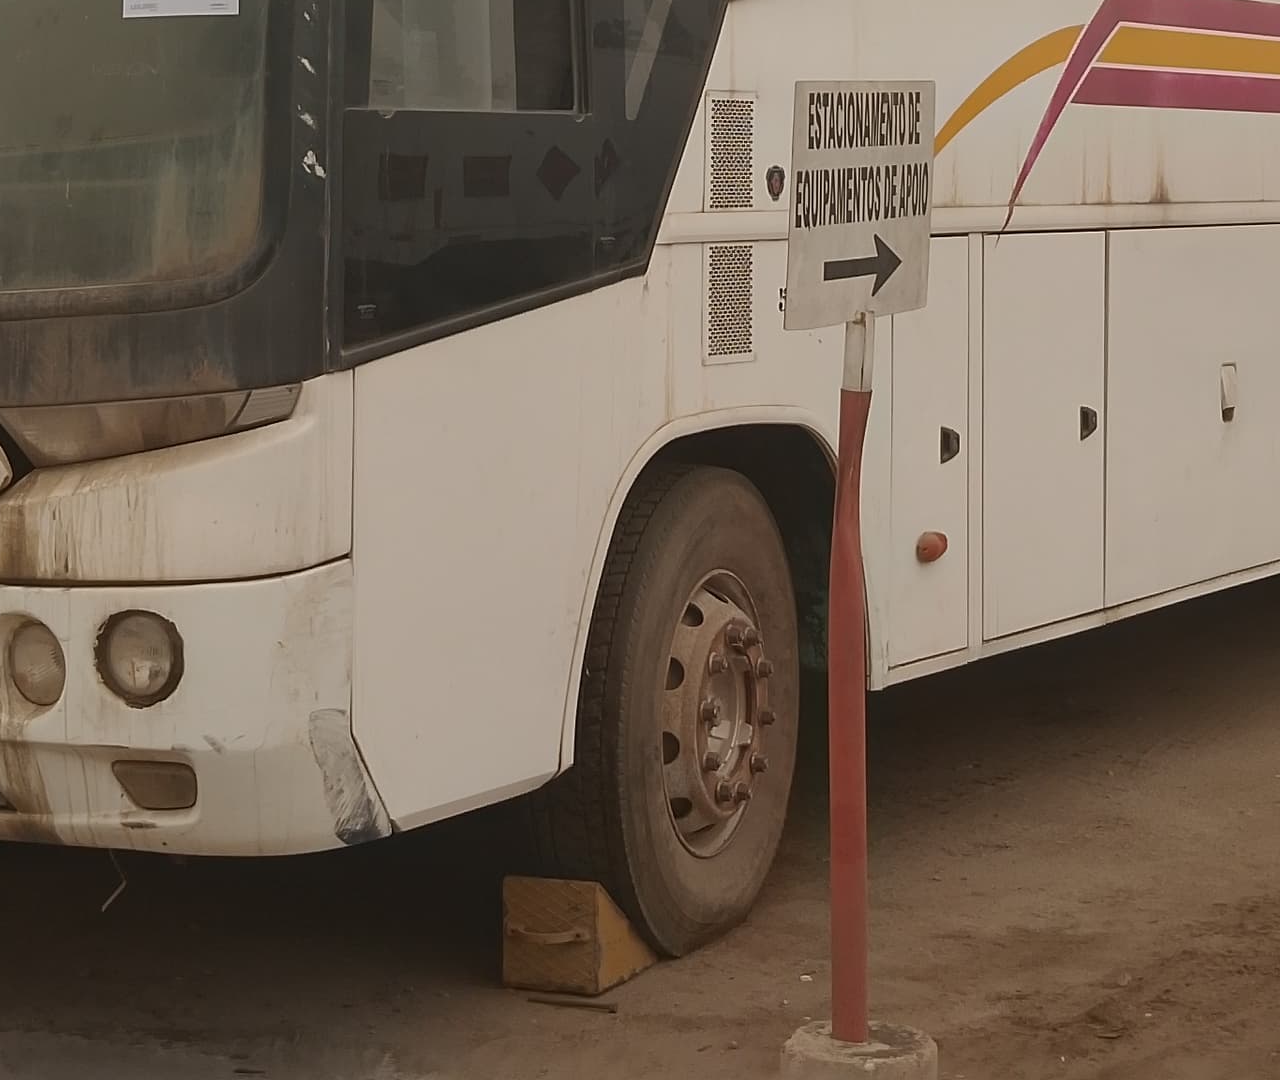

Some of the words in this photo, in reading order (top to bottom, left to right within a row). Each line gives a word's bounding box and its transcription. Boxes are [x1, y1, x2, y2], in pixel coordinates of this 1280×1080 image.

[808, 91, 905, 150] ESTACIONAMENTO
[908, 91, 921, 145] DE
[795, 166, 881, 231] EQUIPAMENTOS
[883, 164, 897, 220] DE
[899, 162, 929, 218] APOIO
